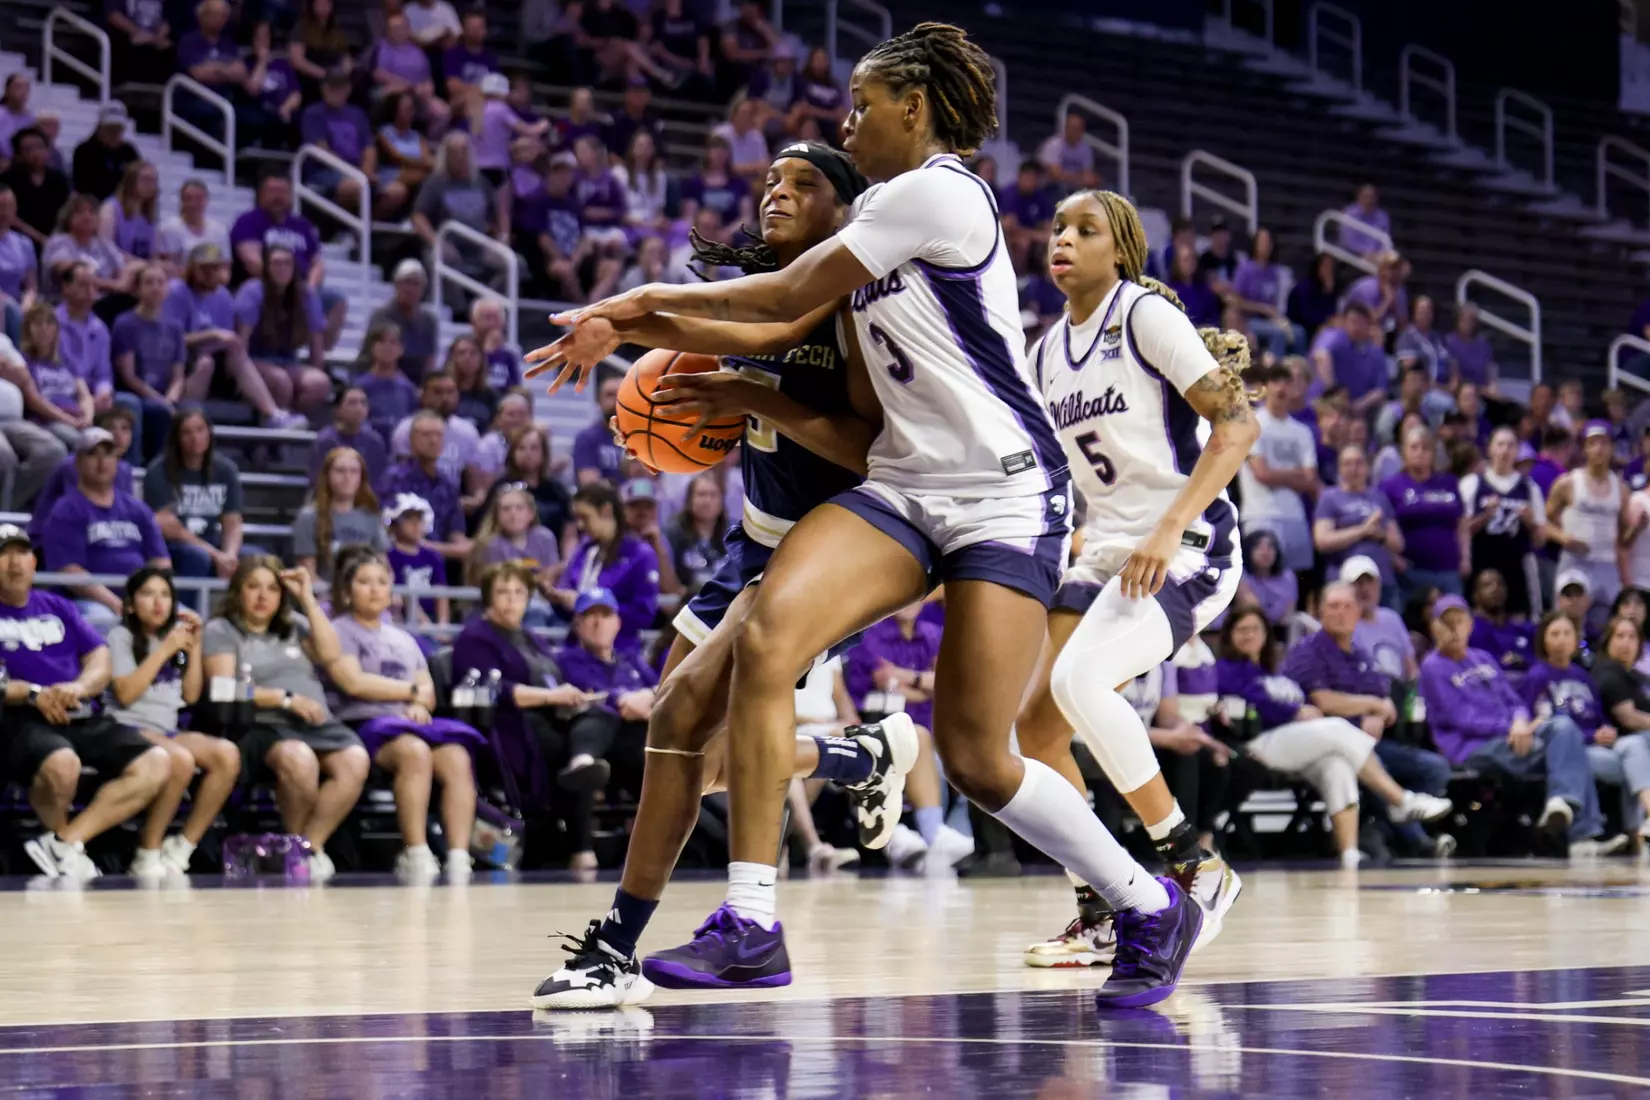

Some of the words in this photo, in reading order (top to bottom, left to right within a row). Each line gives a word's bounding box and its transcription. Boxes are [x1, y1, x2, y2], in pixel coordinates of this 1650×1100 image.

[853, 268, 907, 312] cats
[782, 345, 835, 369] TECH
[868, 322, 915, 384] 3
[1050, 385, 1129, 431] Wildcats
[1075, 430, 1117, 486] 5
